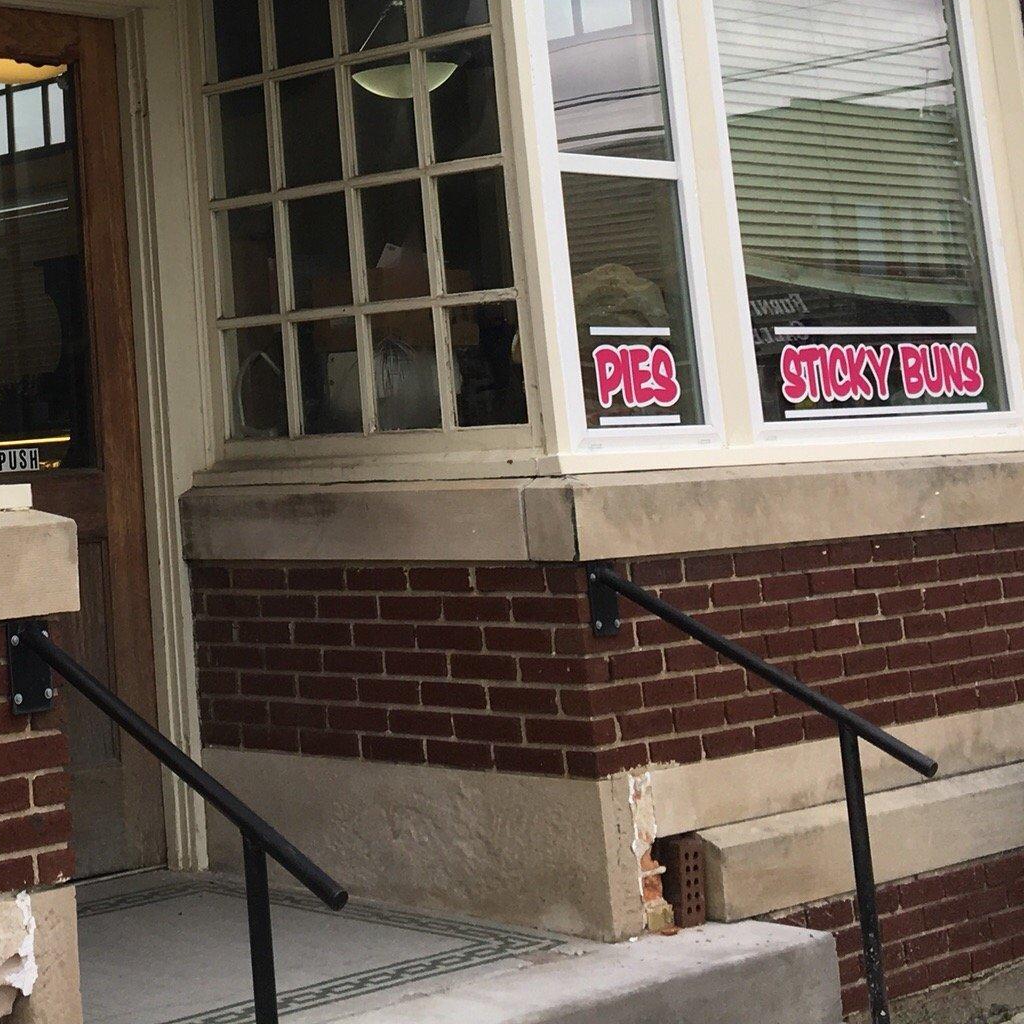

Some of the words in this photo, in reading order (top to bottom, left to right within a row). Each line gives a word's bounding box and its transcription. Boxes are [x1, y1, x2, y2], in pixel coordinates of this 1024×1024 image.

[593, 344, 681, 408] PIES
[781, 343, 892, 403] STICKY
[899, 343, 983, 400] BUNS
